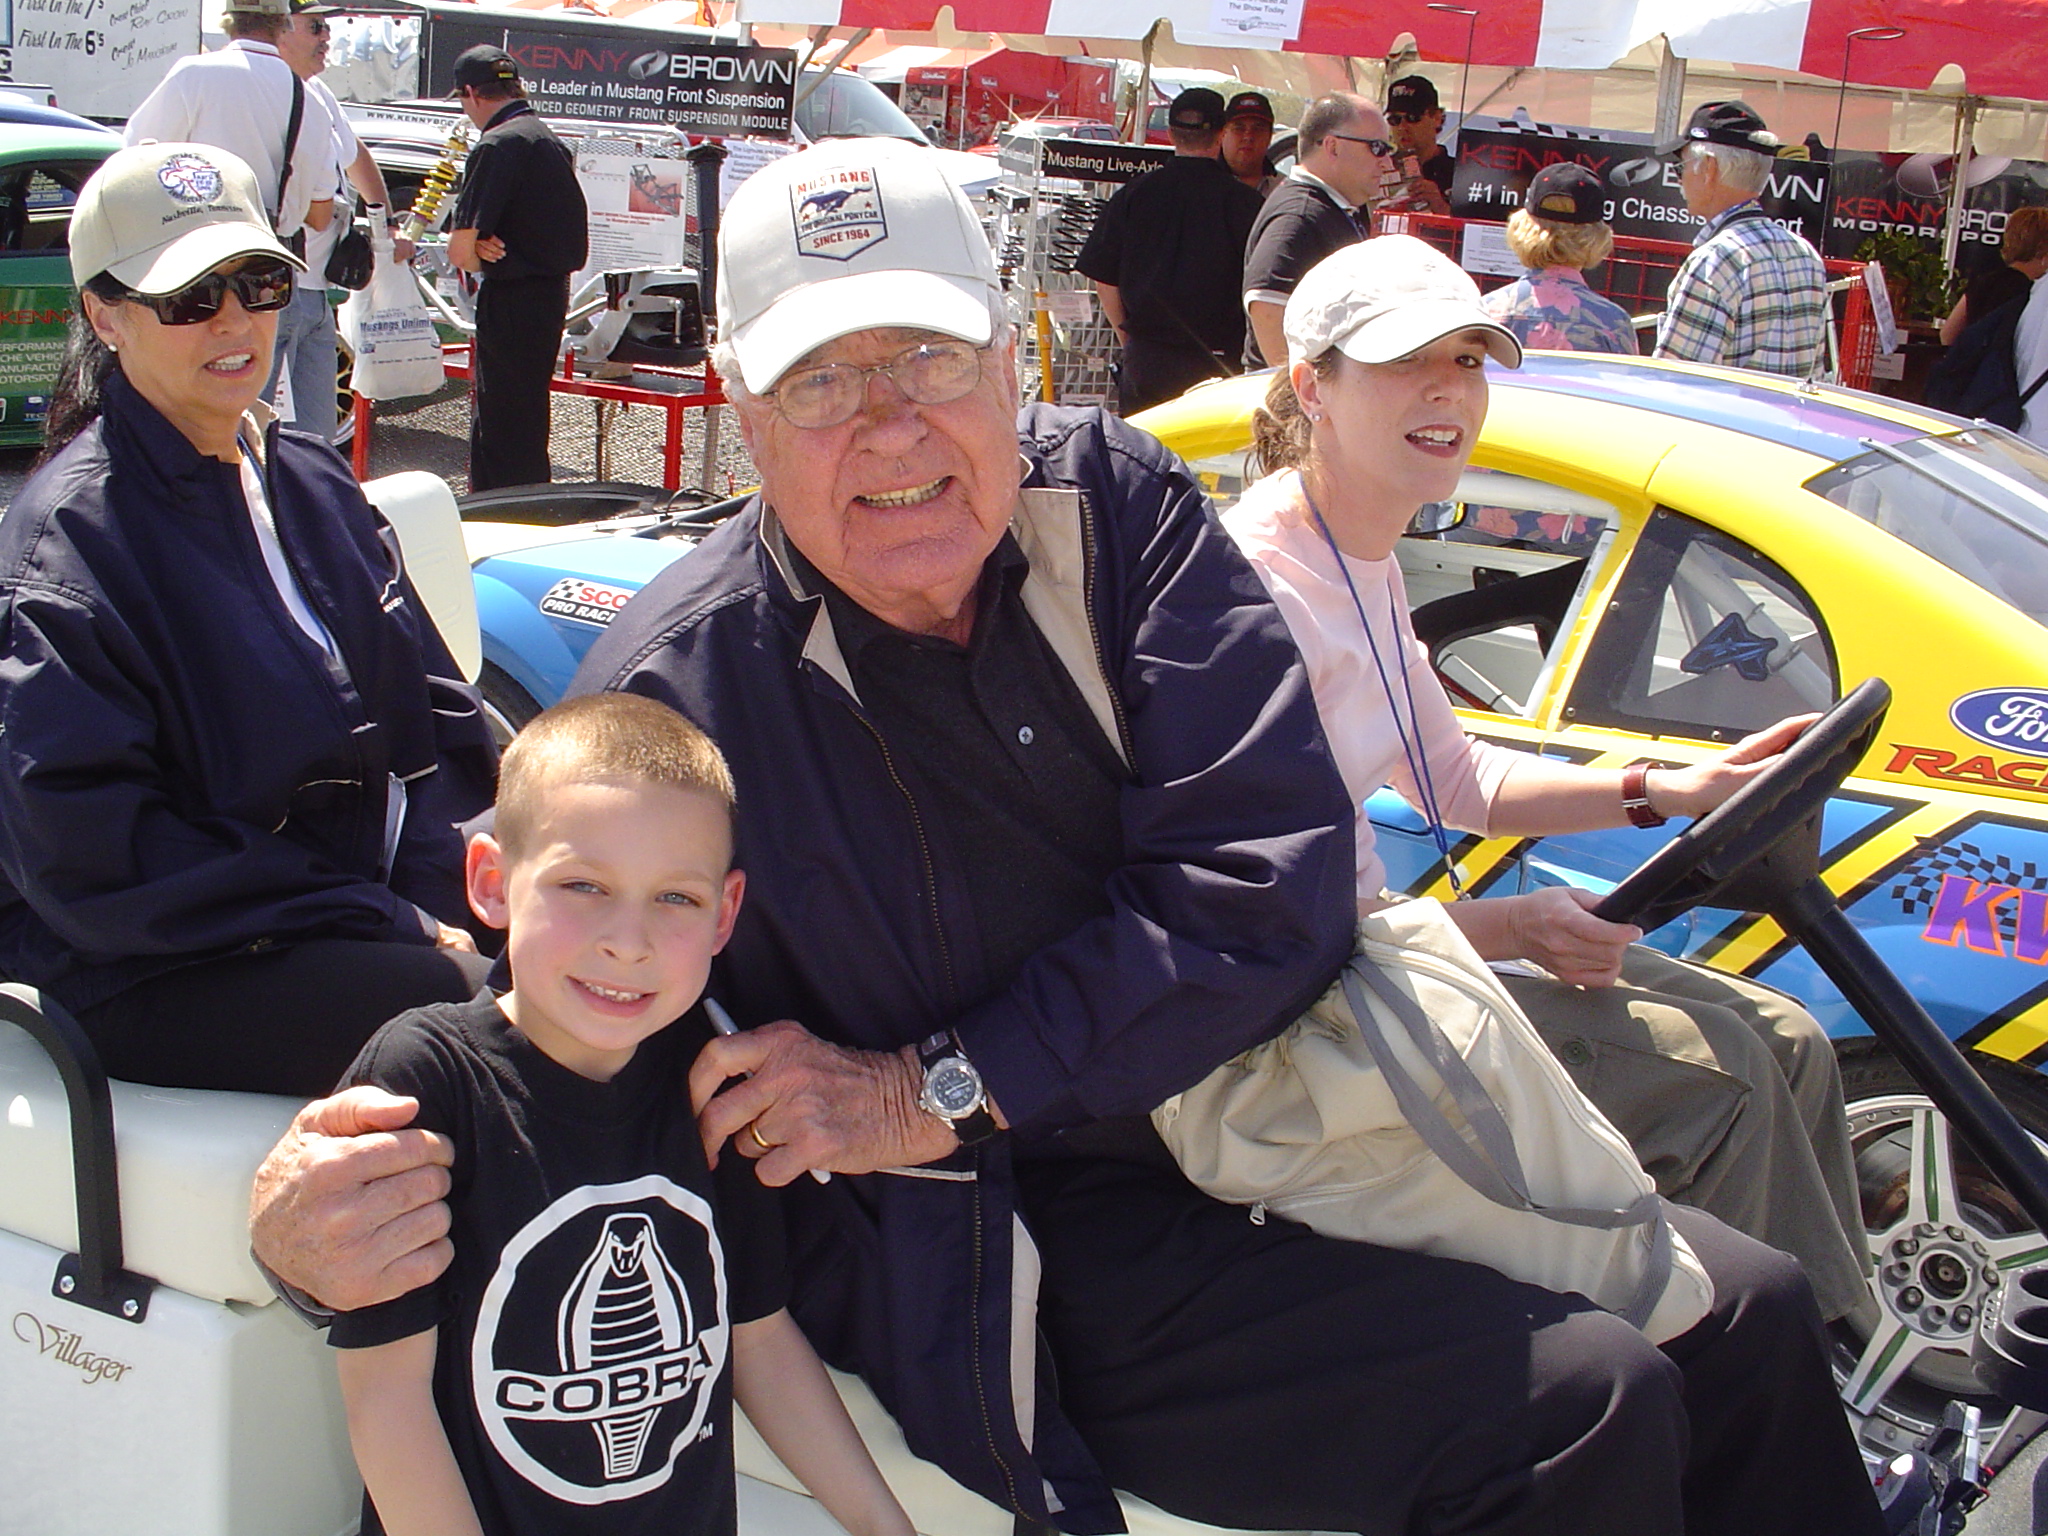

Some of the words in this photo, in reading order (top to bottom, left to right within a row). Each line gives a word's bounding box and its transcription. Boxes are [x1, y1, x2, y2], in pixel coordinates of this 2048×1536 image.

[508, 43, 629, 73] KENNY
[669, 54, 793, 86] BROWN
[540, 78, 589, 96] Leader
[591, 82, 603, 97] in
[606, 82, 663, 105] Mustang
[667, 86, 702, 104] Front
[705, 88, 785, 110] Suspension
[565, 102, 624, 118] GEOMETRY
[629, 106, 665, 121] FRONT
[667, 109, 738, 127] SUSPENSION
[741, 114, 788, 130] MODULE
[1047, 152, 1104, 173] Mustang
[797, 171, 870, 195] MUSTANG
[1467, 181, 1493, 204] #1
[1500, 184, 1518, 206] in
[1835, 196, 1947, 226] KENNY
[1949, 206, 2013, 232] BRO
[813, 231, 844, 249] SINCE
[845, 229, 871, 240] 1964
[543, 598, 577, 614] PRO
[575, 604, 617, 623] RACI
[1985, 695, 2048, 743] Fo
[13, 1312, 133, 1385] Villager
[496, 1337, 714, 1414] COBRA
[699, 1422, 714, 1442] TM
